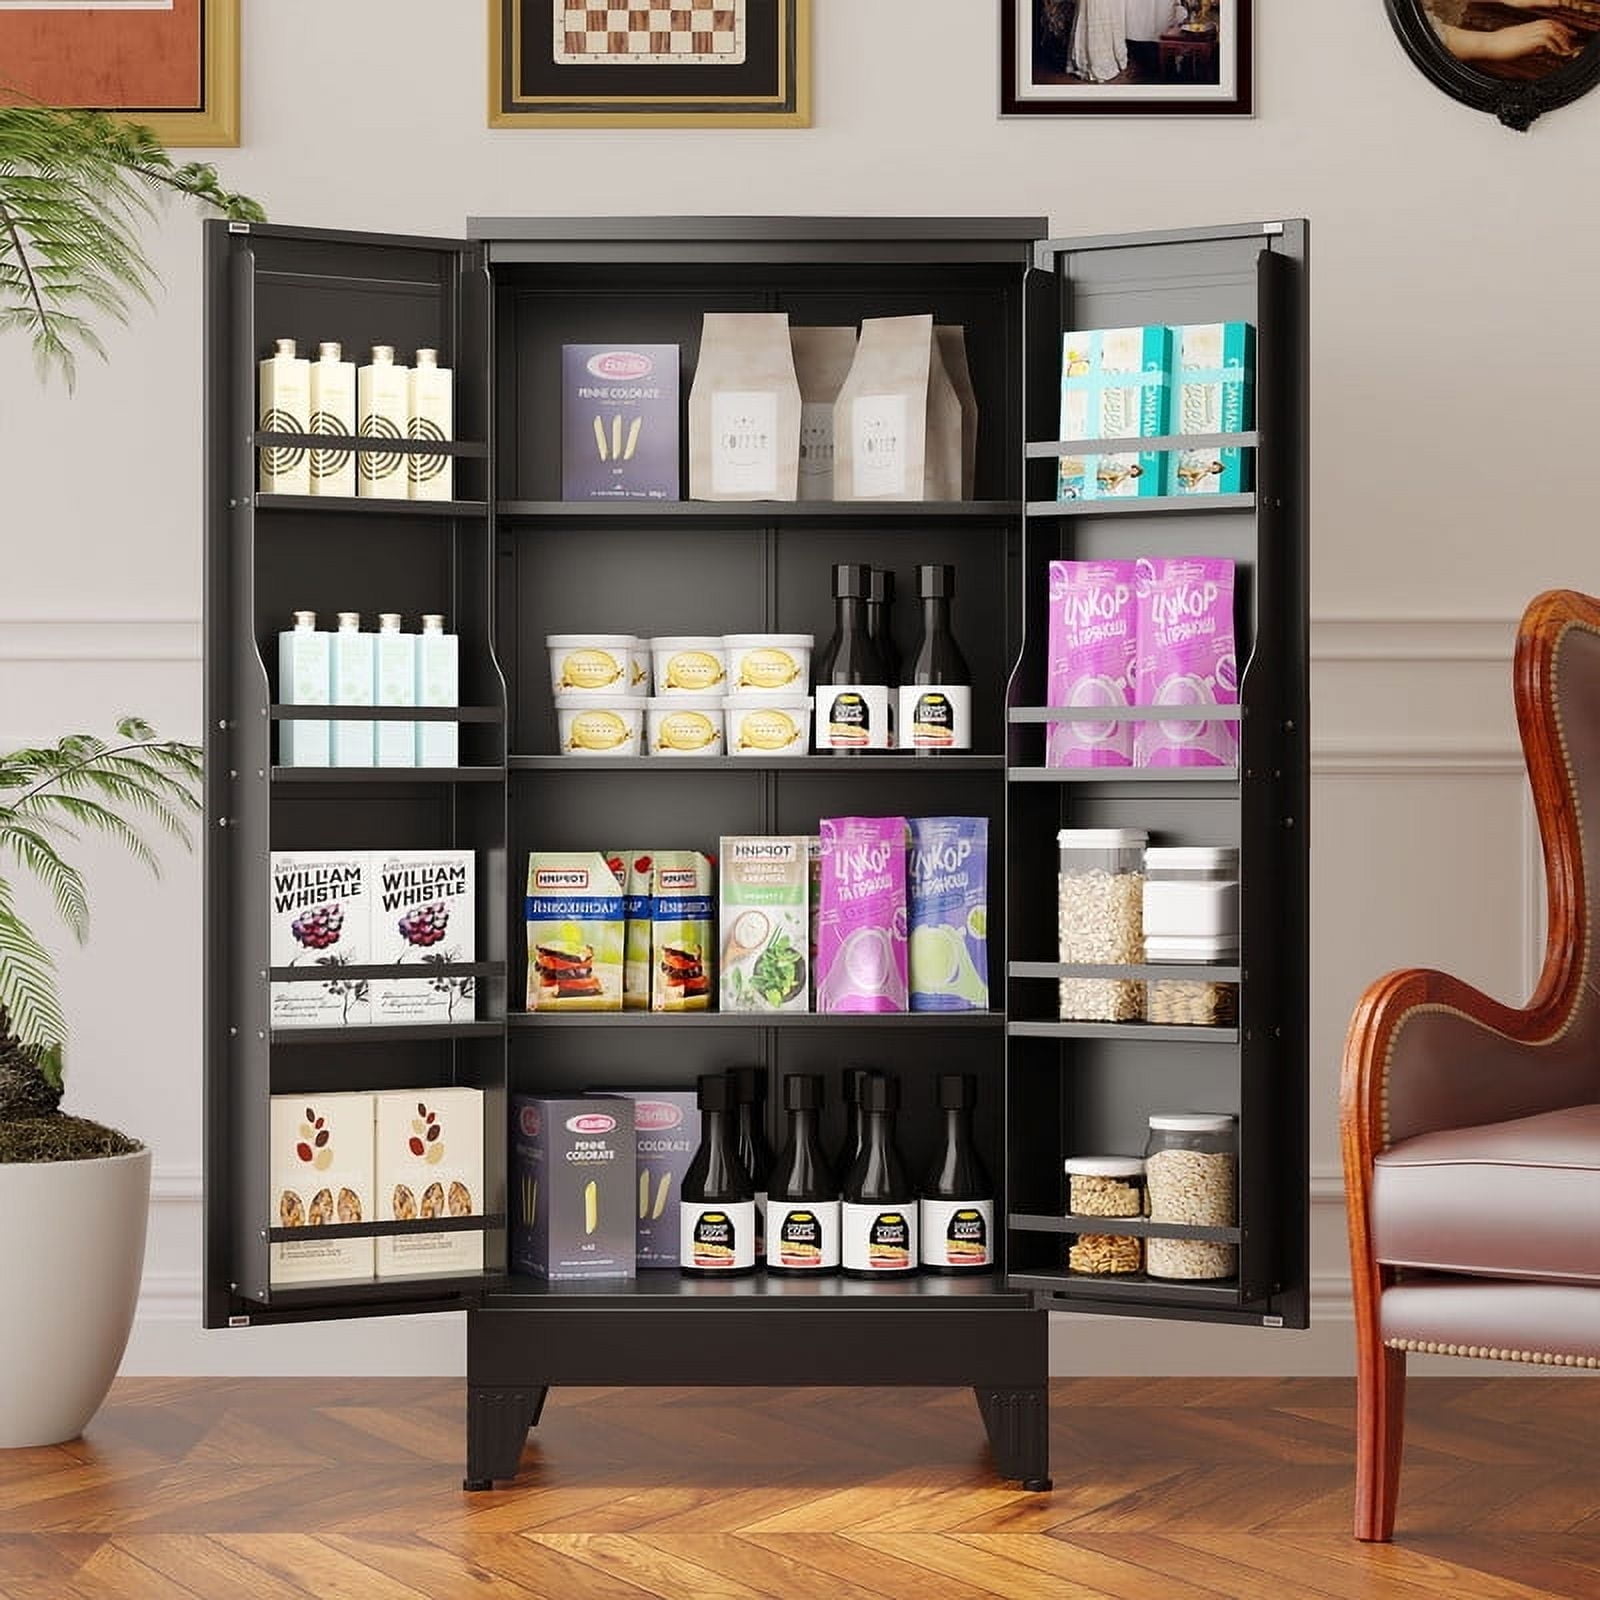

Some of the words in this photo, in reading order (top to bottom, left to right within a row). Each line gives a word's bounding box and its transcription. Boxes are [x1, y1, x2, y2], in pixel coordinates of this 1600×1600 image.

[275, 867, 361, 894] WILLIAM
[382, 866, 466, 893] WILLIAM
[275, 883, 362, 913] WHISTLE
[382, 881, 466, 912] WHISTLE
